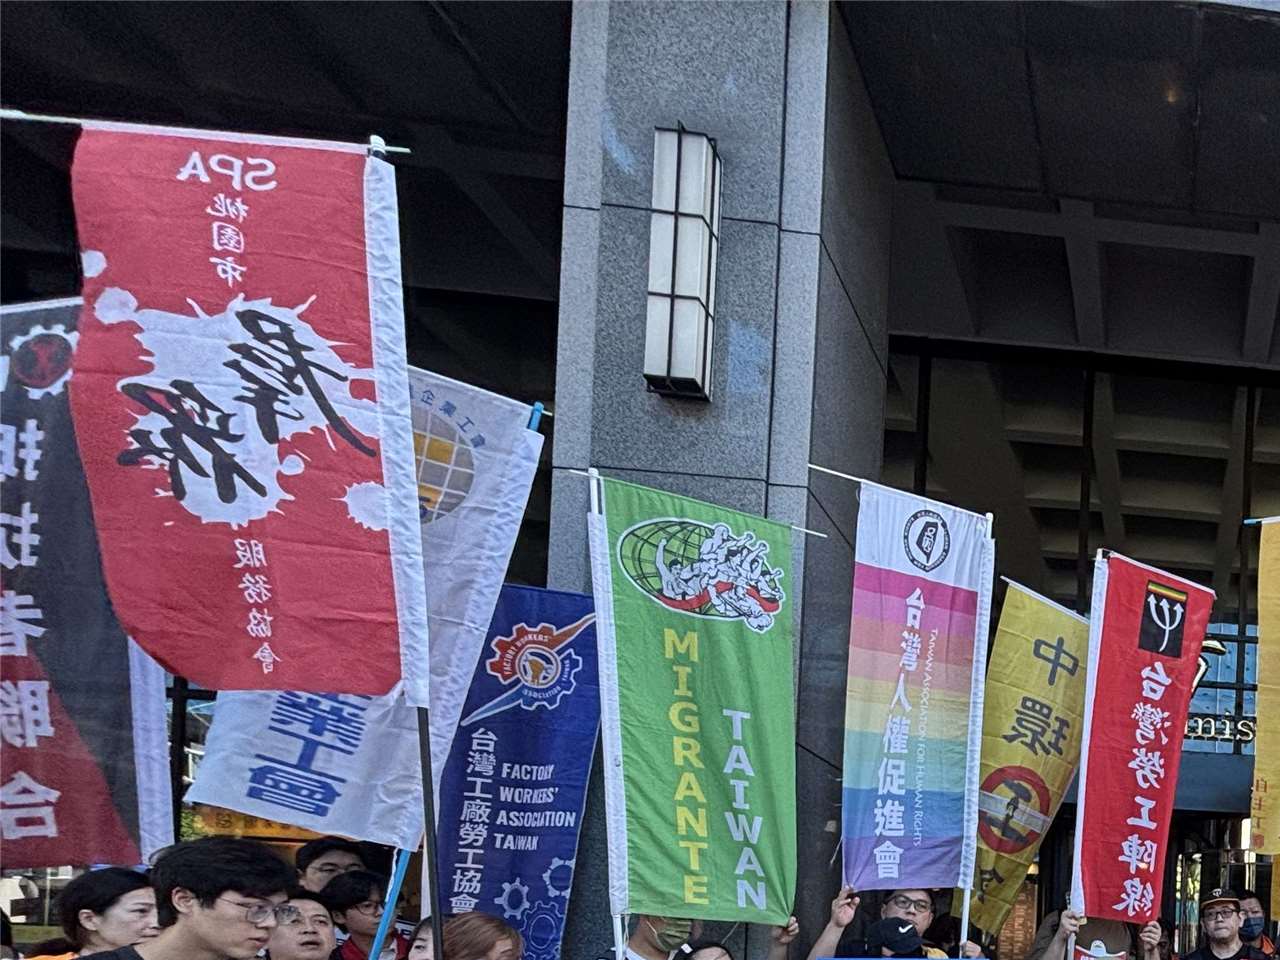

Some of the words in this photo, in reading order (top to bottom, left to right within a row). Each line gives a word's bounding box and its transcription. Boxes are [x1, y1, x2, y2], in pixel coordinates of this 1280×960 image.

[926, 628, 939, 674] TAIWAN
[918, 675, 936, 739] ASSOCIATION
[871, 587, 926, 880] 台灣人權促進會
[501, 762, 555, 781] FACTORY
[663, 628, 710, 906] MIGRANTE
[914, 762, 927, 803] HUMAN
[499, 786, 559, 804] WORKERS'
[722, 709, 767, 911] TAIWAN
[448, 727, 499, 914] 台灣工廠勞工協會
[496, 810, 576, 828] ASSOCIATION
[911, 805, 924, 847] RIGHTS
[494, 833, 539, 851] TAIWAN
